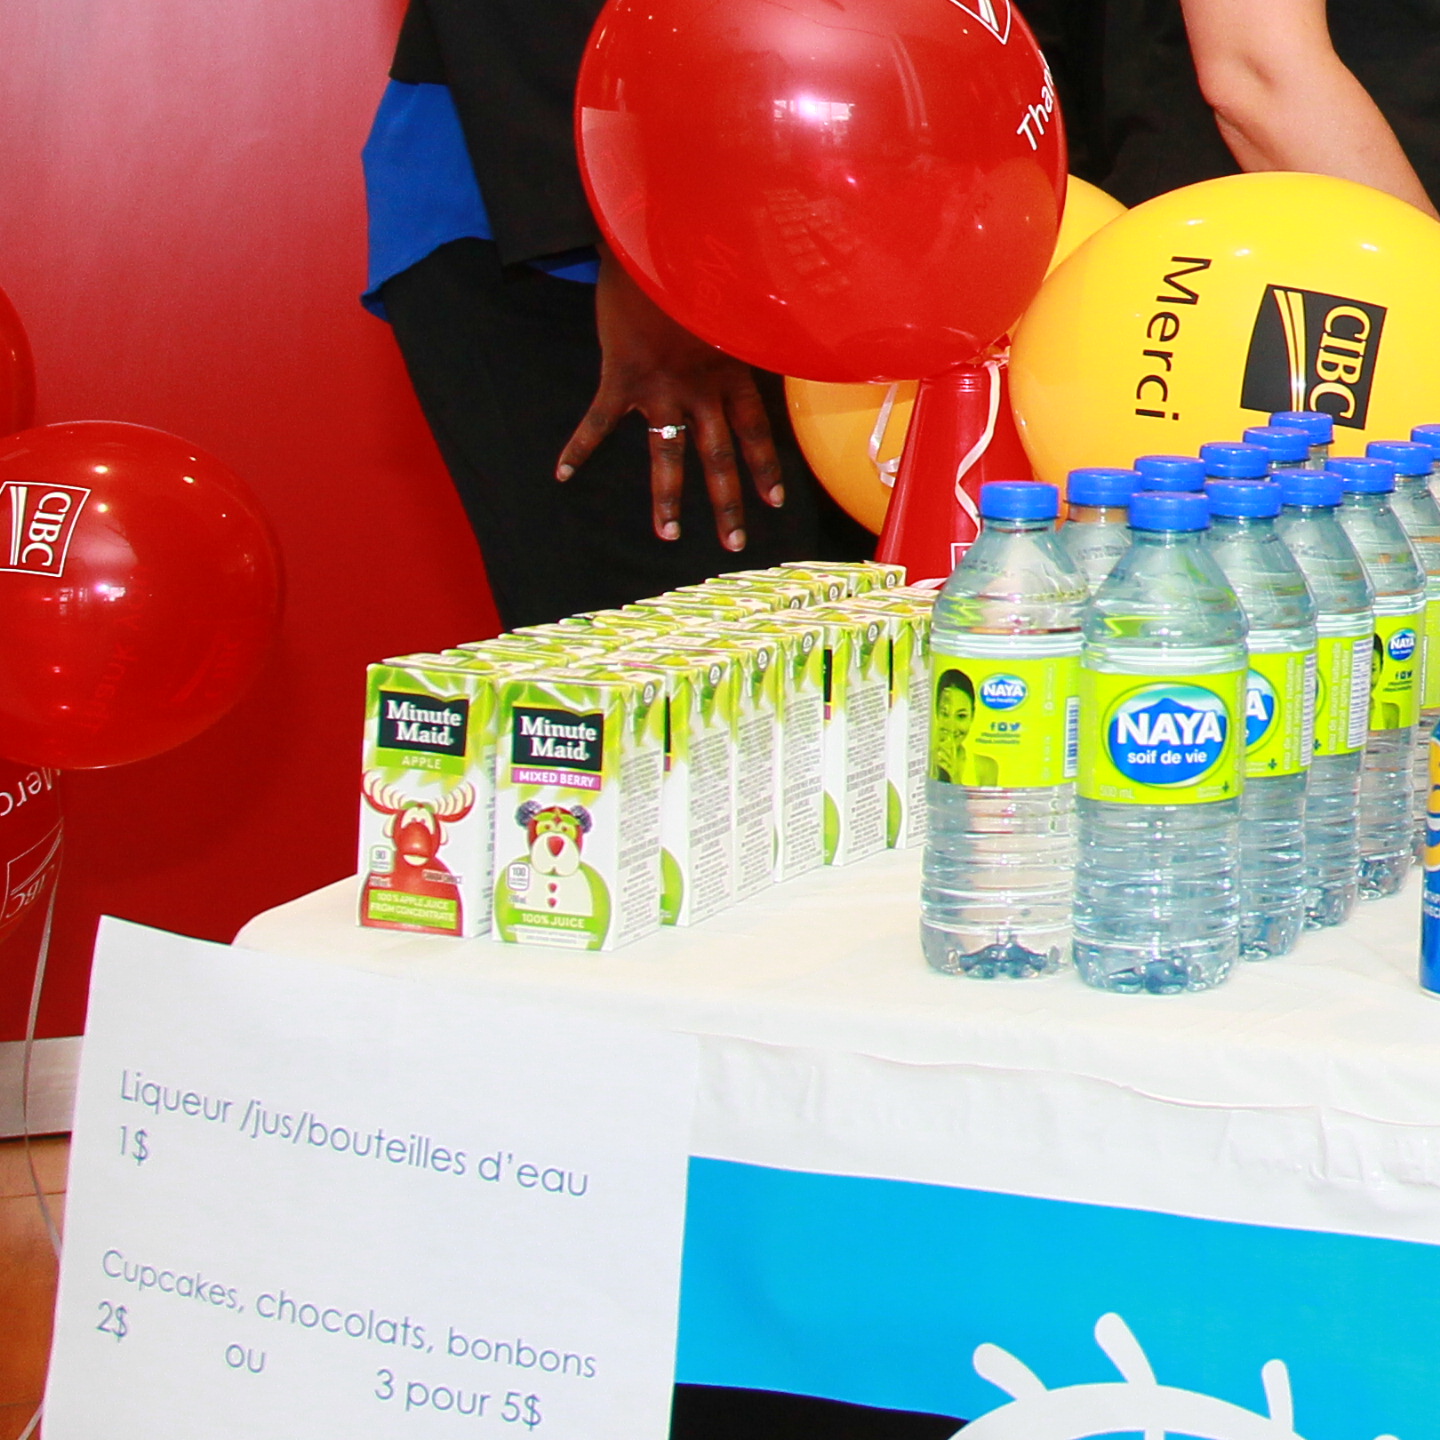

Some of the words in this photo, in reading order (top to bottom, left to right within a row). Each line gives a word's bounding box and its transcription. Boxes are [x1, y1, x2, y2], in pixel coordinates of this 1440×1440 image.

[1135, 256, 1213, 421] Merci
[1308, 305, 1372, 420] CIBC
[22, 491, 72, 567] CIBC
[983, 684, 1024, 698] NAYA
[386, 699, 462, 727] Minute
[520, 715, 598, 742] Minute
[1117, 711, 1223, 746] NAYA
[395, 721, 454, 747] Maid
[530, 737, 590, 761] Maid
[401, 755, 442, 770] APPLE
[1127, 750, 1158, 765] soif
[1160, 750, 1182, 765] de
[1185, 748, 1208, 764] vie
[519, 771, 558, 783] MIXED
[560, 773, 596, 788] BERRY
[522, 913, 549, 925] 100%
[551, 916, 585, 929] JUICE
[120, 1069, 233, 1123] Liqueur
[240, 1099, 467, 1175] /jus/bouteilles
[478, 1151, 590, 1197] d'eau
[120, 1124, 150, 1167] 1$
[95, 1300, 129, 1343] 2$
[101, 1248, 245, 1314] Cupcakes,
[255, 1289, 435, 1354] chocolats,
[446, 1325, 598, 1379] bonbons
[224, 1343, 267, 1374] ou
[374, 1368, 395, 1401] 3
[405, 1378, 491, 1417] pour
[500, 1391, 543, 1432] 5$
